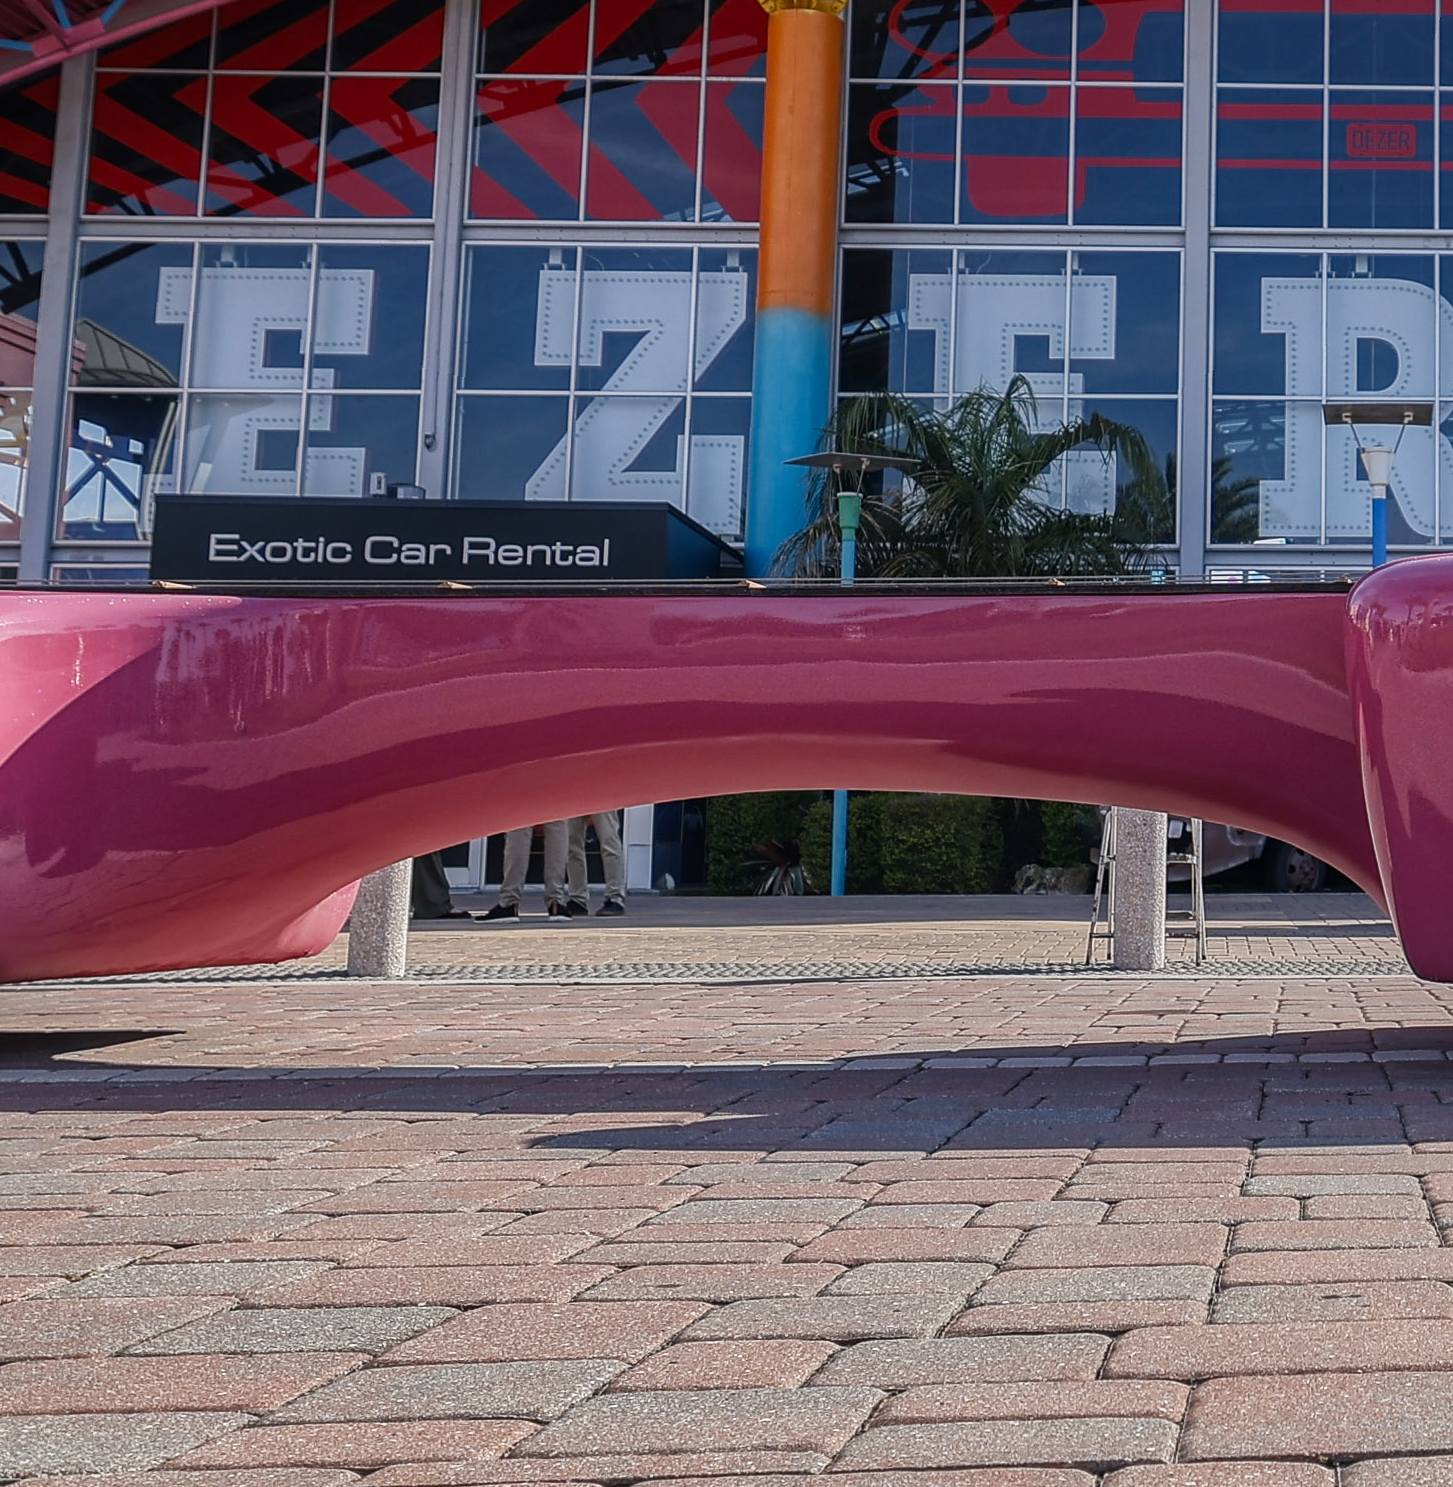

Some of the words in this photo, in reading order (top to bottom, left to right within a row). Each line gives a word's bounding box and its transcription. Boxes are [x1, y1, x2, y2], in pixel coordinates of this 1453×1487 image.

[208, 533, 353, 563] Exotic
[364, 535, 452, 565] Car
[462, 536, 610, 567] Rental
